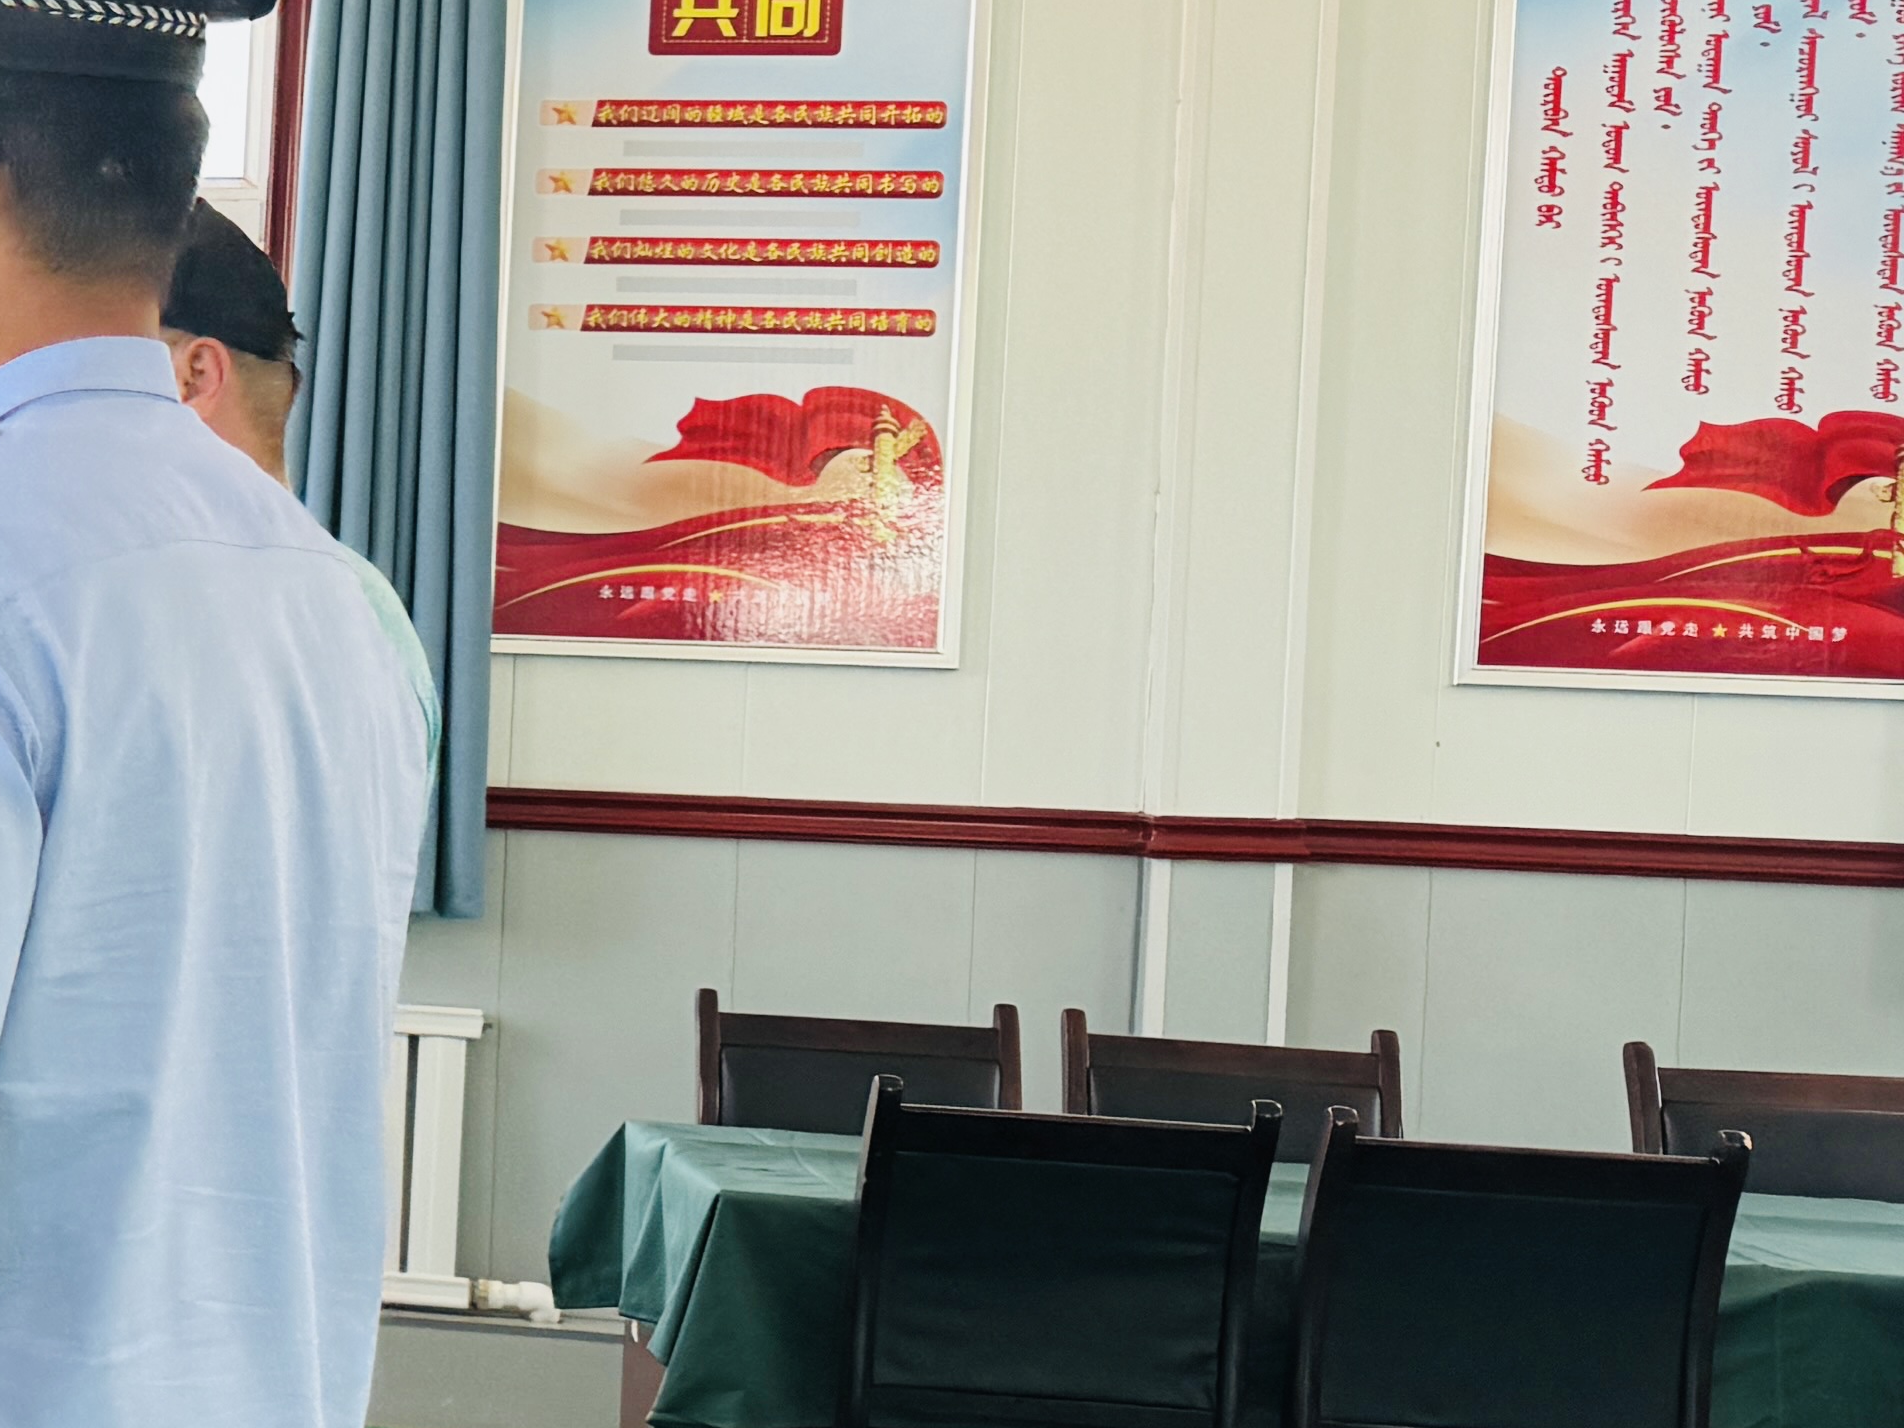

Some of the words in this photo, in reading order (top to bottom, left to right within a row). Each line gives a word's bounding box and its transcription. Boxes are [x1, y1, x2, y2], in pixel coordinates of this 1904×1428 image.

[1738, 623, 1847, 642] 共筑中国梦
